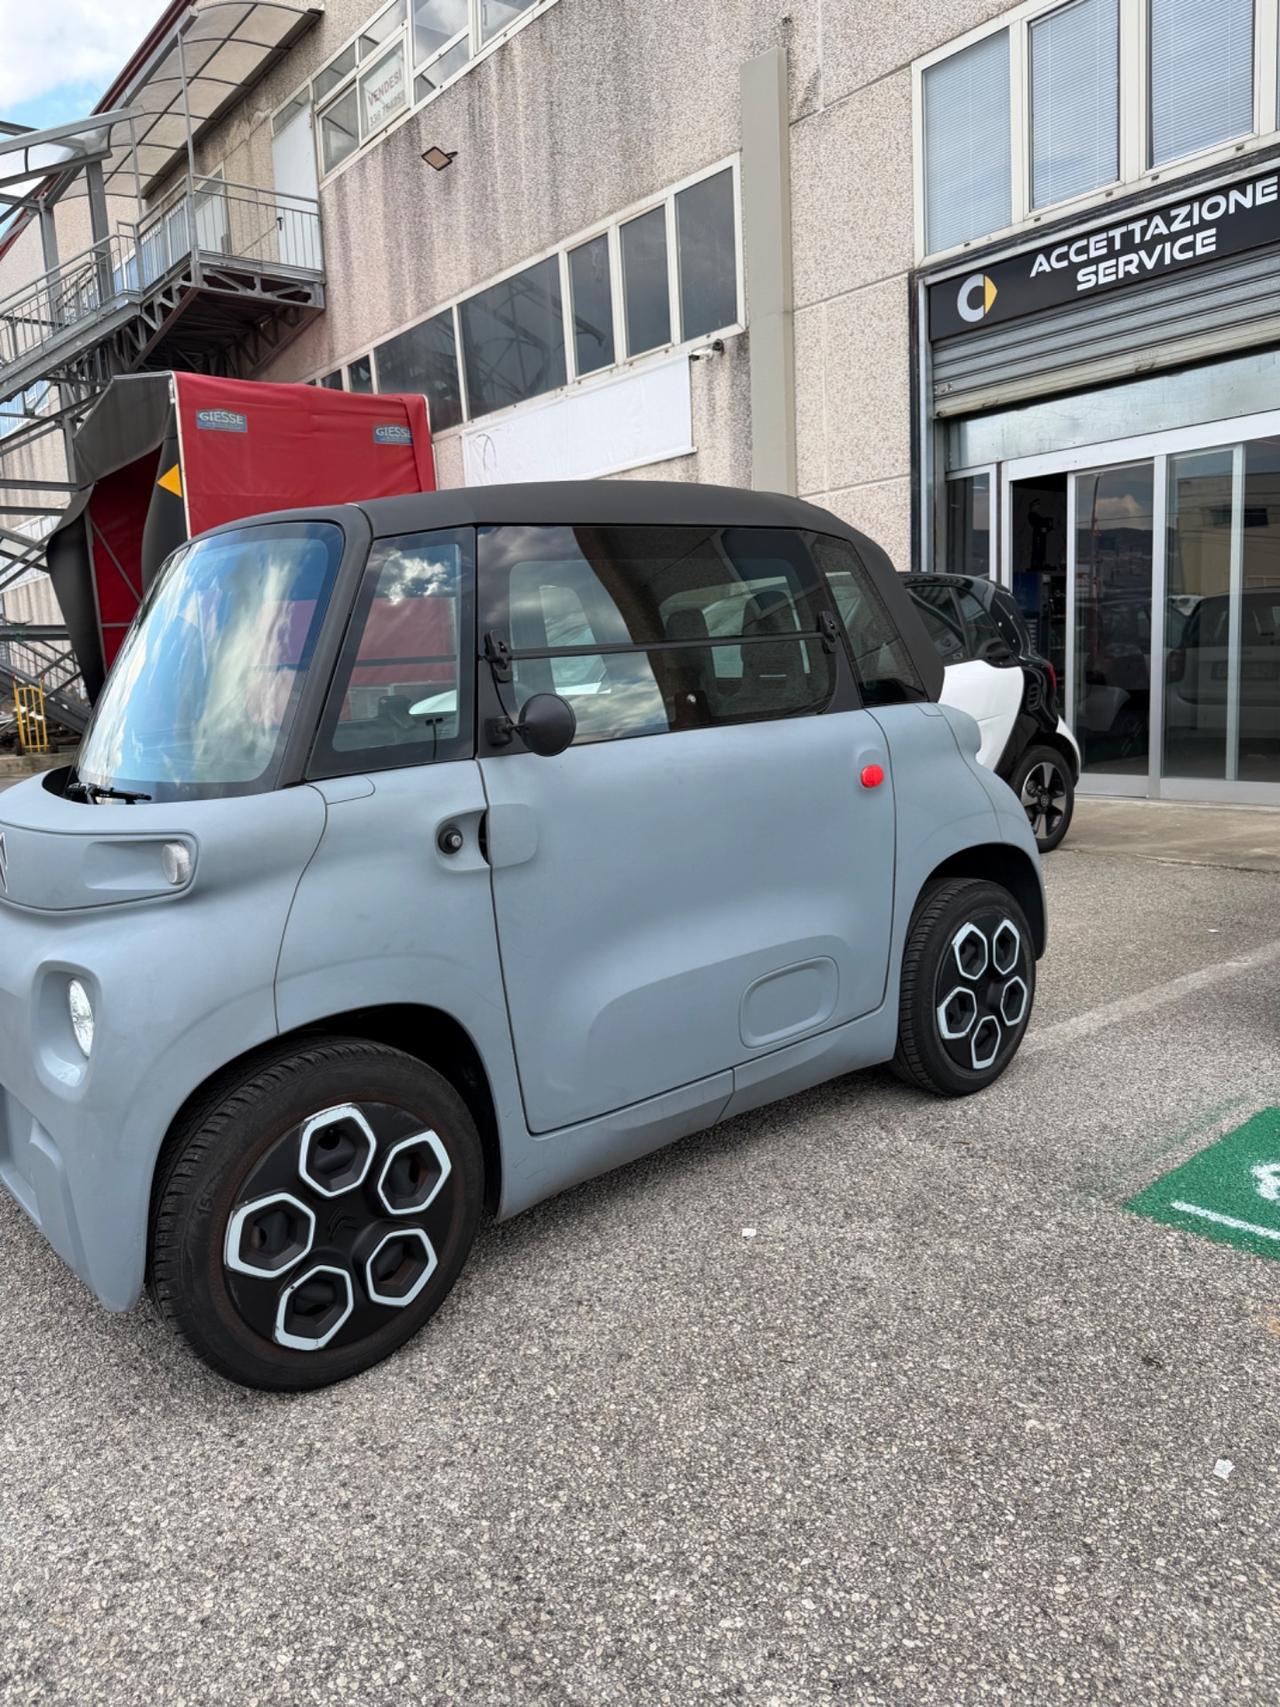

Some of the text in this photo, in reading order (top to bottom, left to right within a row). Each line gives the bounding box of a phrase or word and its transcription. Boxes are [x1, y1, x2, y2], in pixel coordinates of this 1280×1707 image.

[1030, 176, 1279, 278] ACCETTAZIONE
[1076, 227, 1217, 291] SERVICE
[199, 411, 244, 424] GIESSE
